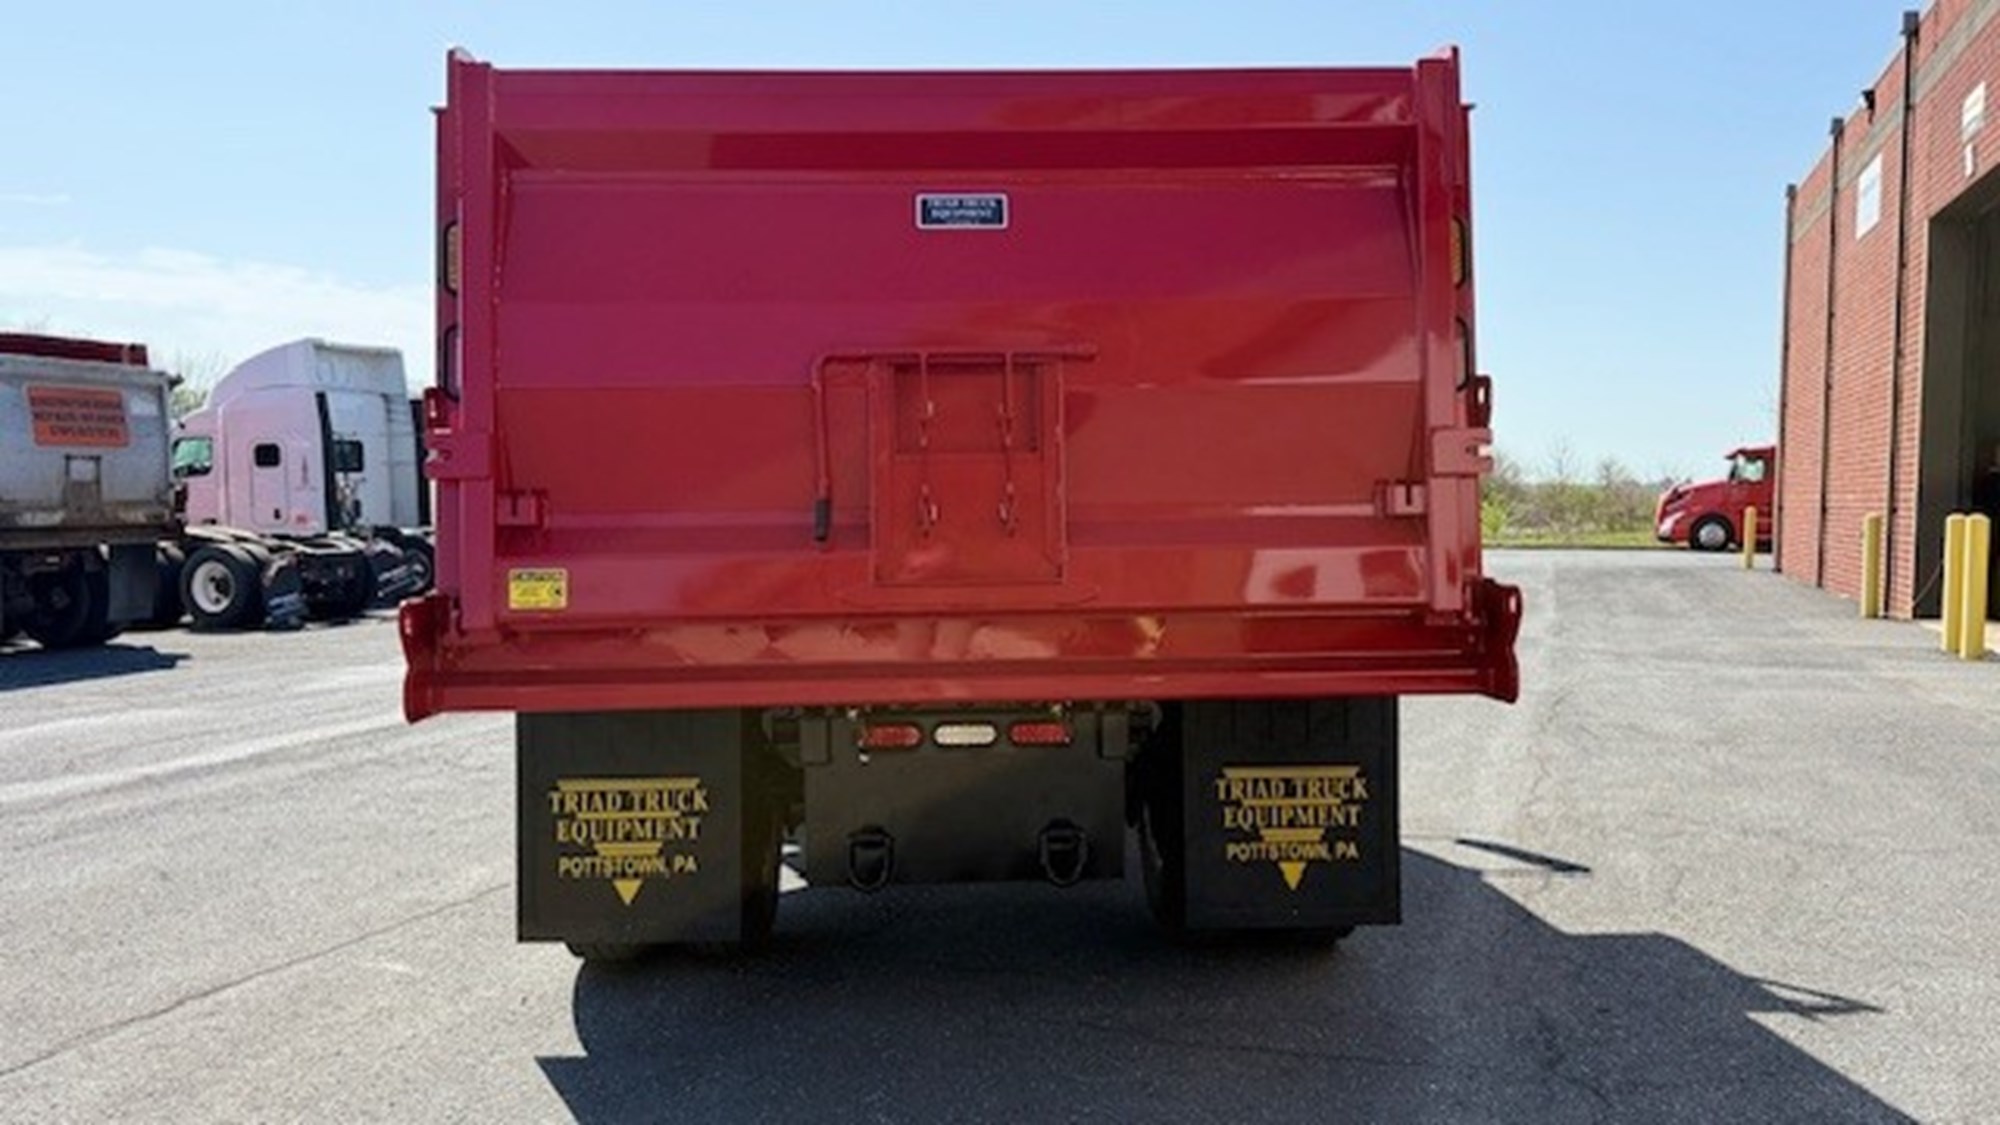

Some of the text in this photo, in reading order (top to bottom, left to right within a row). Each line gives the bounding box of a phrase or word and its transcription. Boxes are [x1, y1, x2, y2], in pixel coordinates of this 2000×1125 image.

[1216, 777, 1368, 800] TRIAD TRUCK
[549, 788, 709, 814] TRIAD TRUCK
[1223, 804, 1361, 832] EQUIPMENT
[557, 817, 700, 846] EQUIPMENT
[1335, 841, 1359, 860] PA
[674, 855, 697, 873] PA
